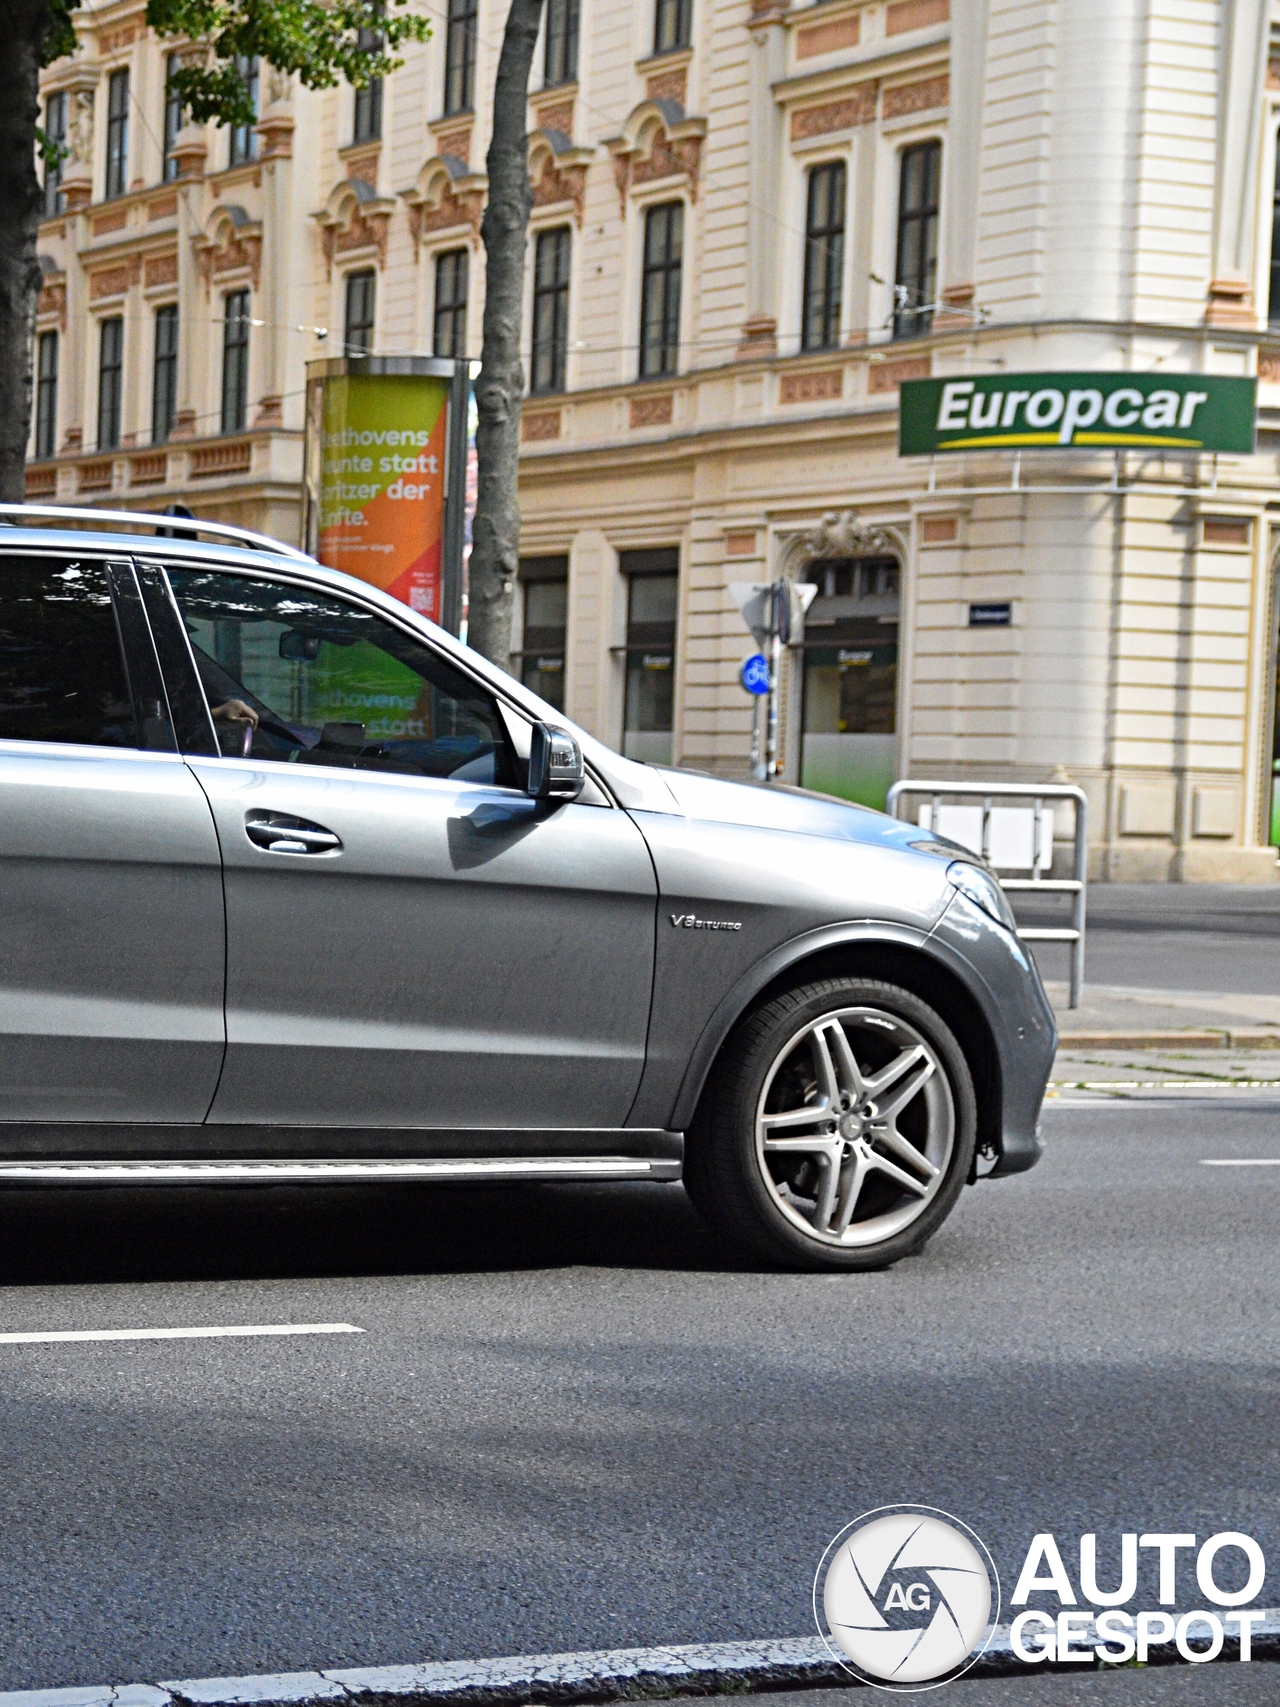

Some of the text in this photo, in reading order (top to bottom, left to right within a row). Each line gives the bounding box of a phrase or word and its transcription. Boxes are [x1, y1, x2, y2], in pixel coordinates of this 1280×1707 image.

[937, 381, 1208, 445] Europcar
[379, 453, 439, 475] statt
[386, 478, 431, 501] der
